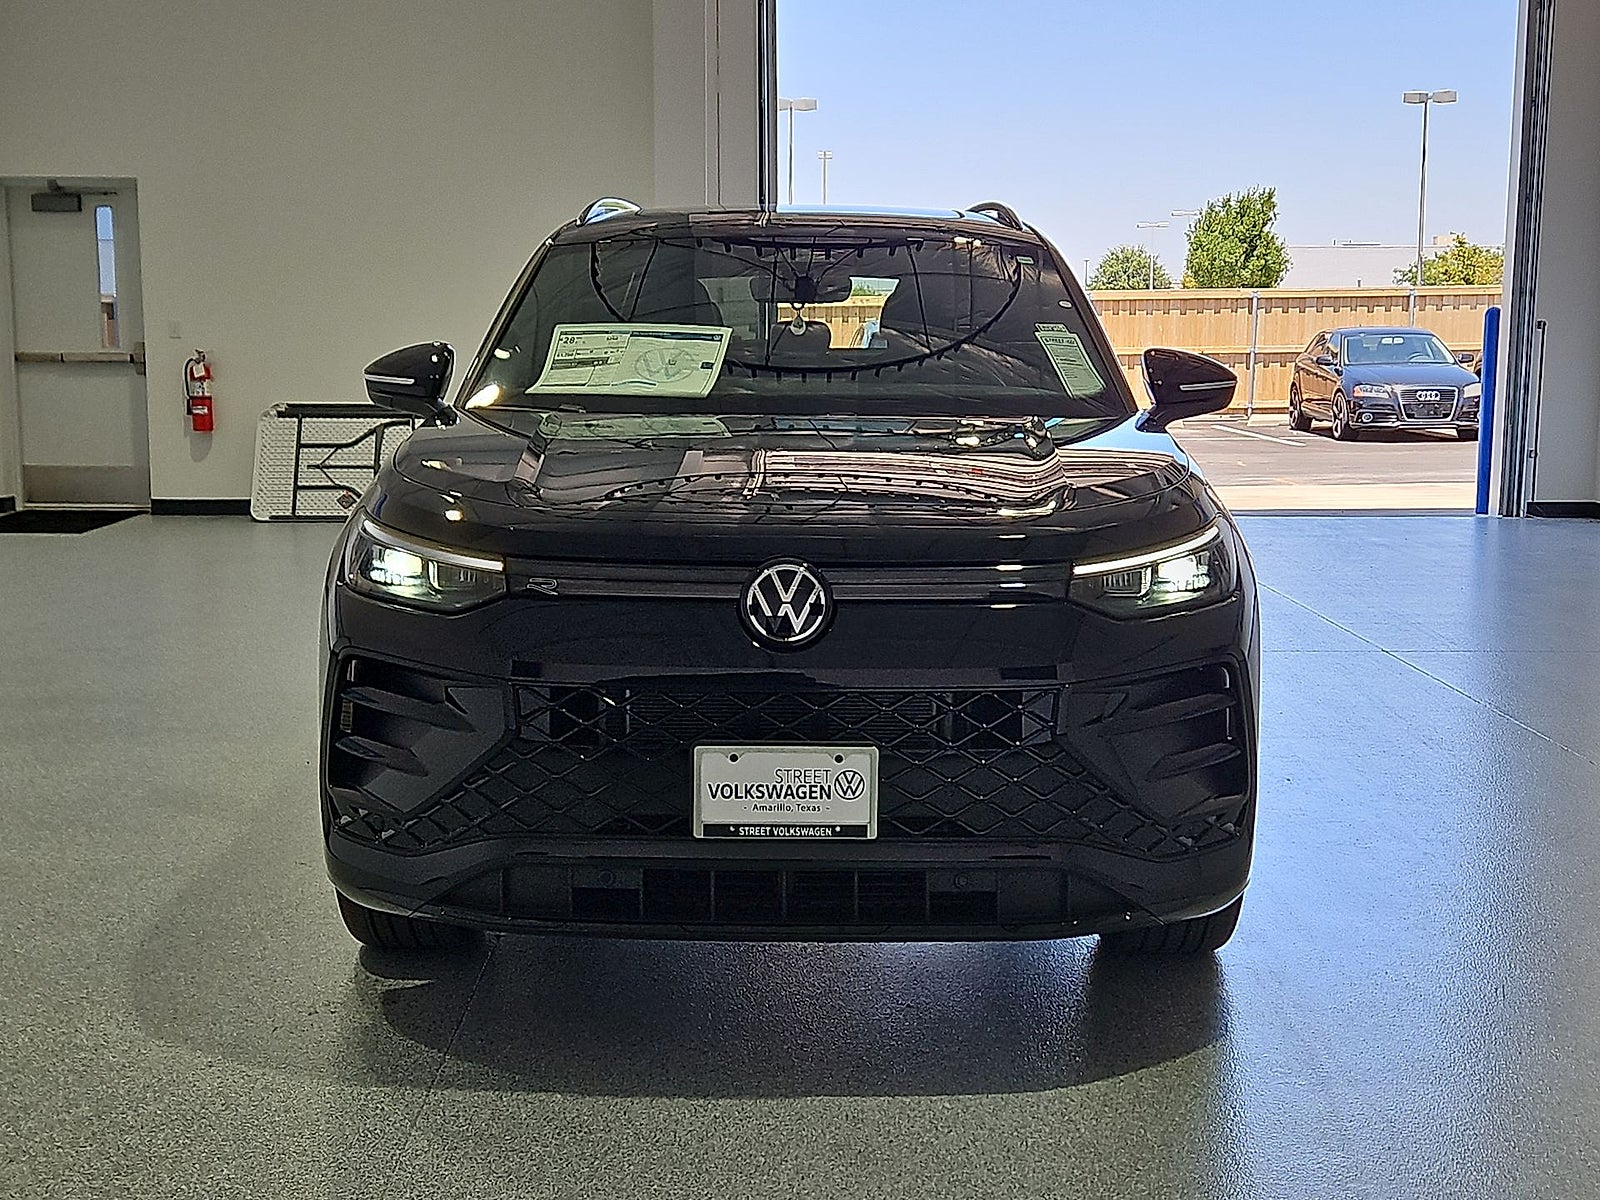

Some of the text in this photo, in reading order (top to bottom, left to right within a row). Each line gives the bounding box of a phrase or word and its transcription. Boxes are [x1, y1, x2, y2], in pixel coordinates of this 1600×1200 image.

[775, 769, 832, 784] STREET
[708, 784, 832, 800] VOLKSWAGEN
[752, 803, 821, 813] Amarillo, Texas
[739, 827, 832, 836] STREET VOLKSWAGEN
